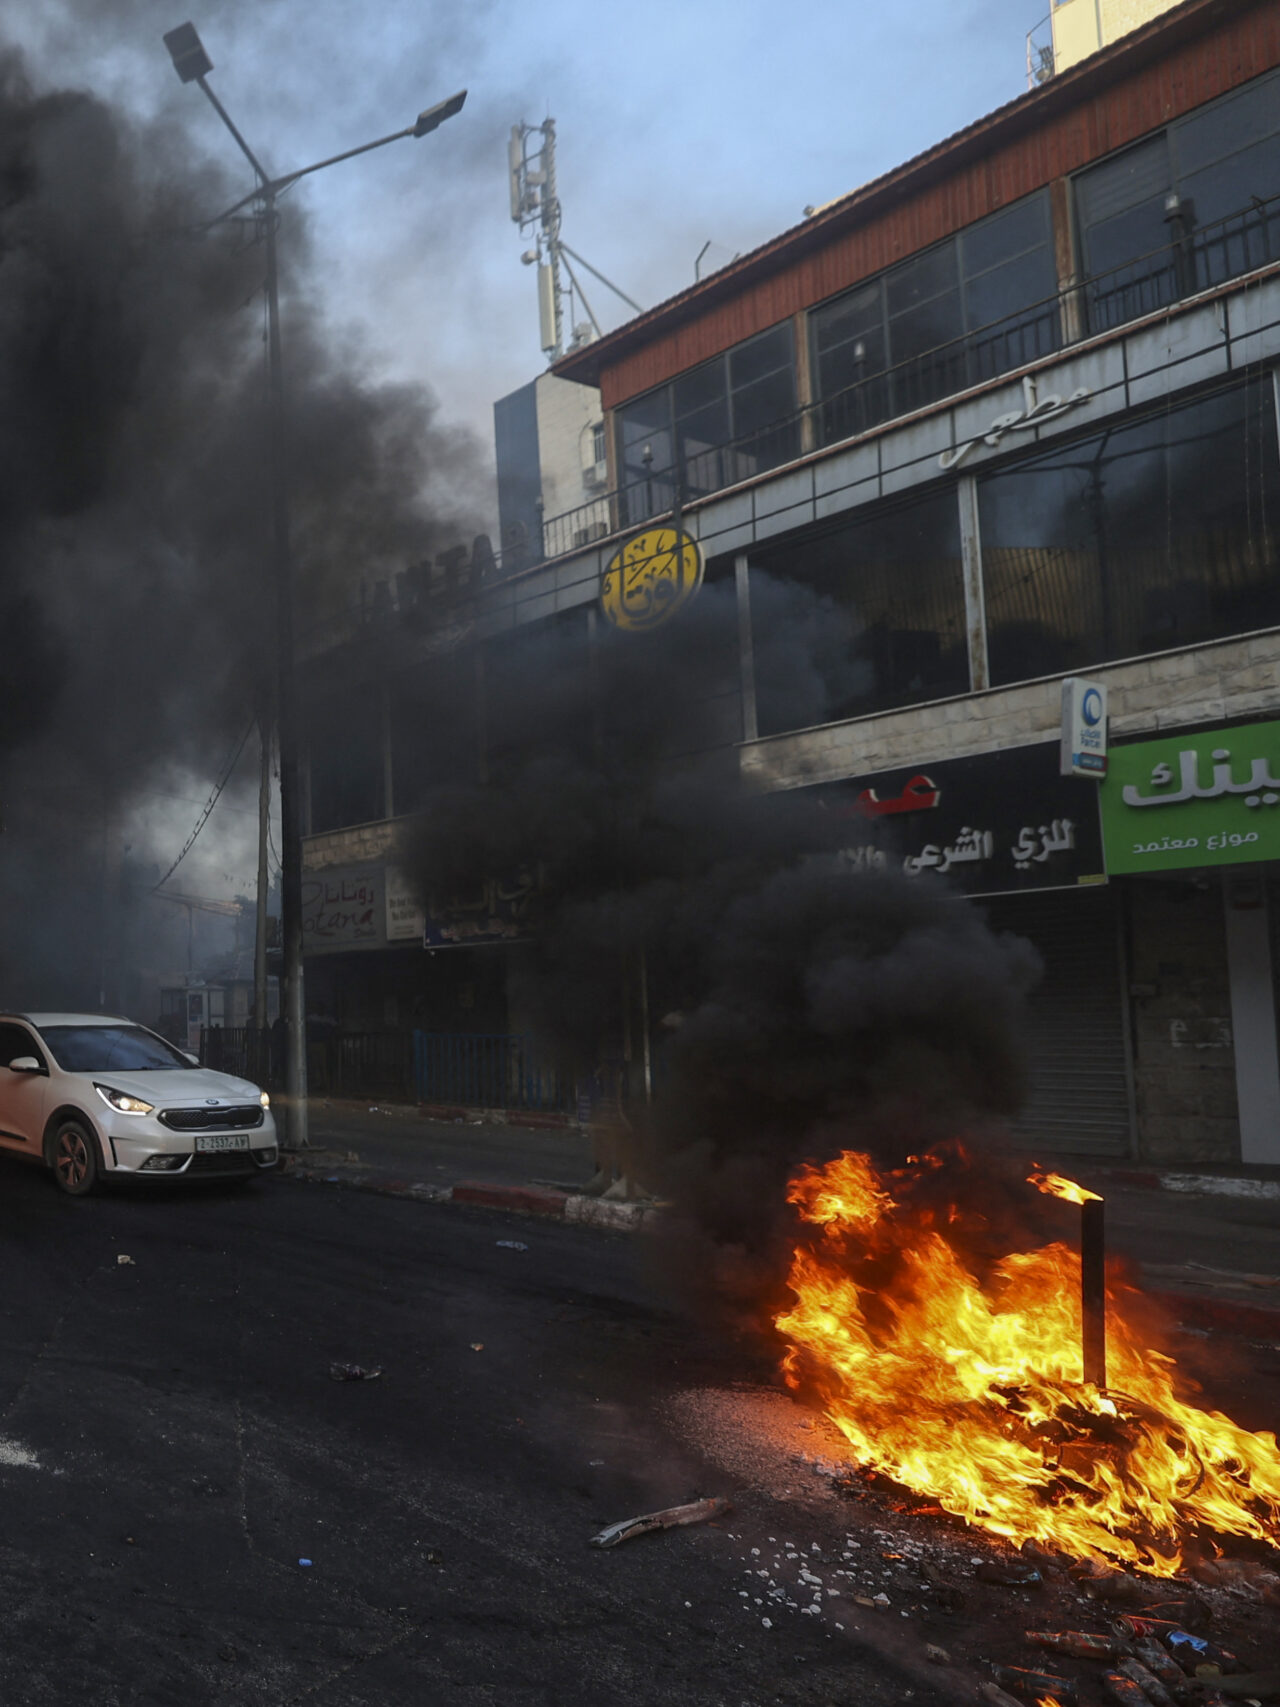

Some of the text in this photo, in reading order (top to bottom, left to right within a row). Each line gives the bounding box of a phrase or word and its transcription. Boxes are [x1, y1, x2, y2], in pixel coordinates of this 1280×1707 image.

[1010, 818, 1078, 870] للزي
[1132, 831, 1259, 854] موزع معتمد
